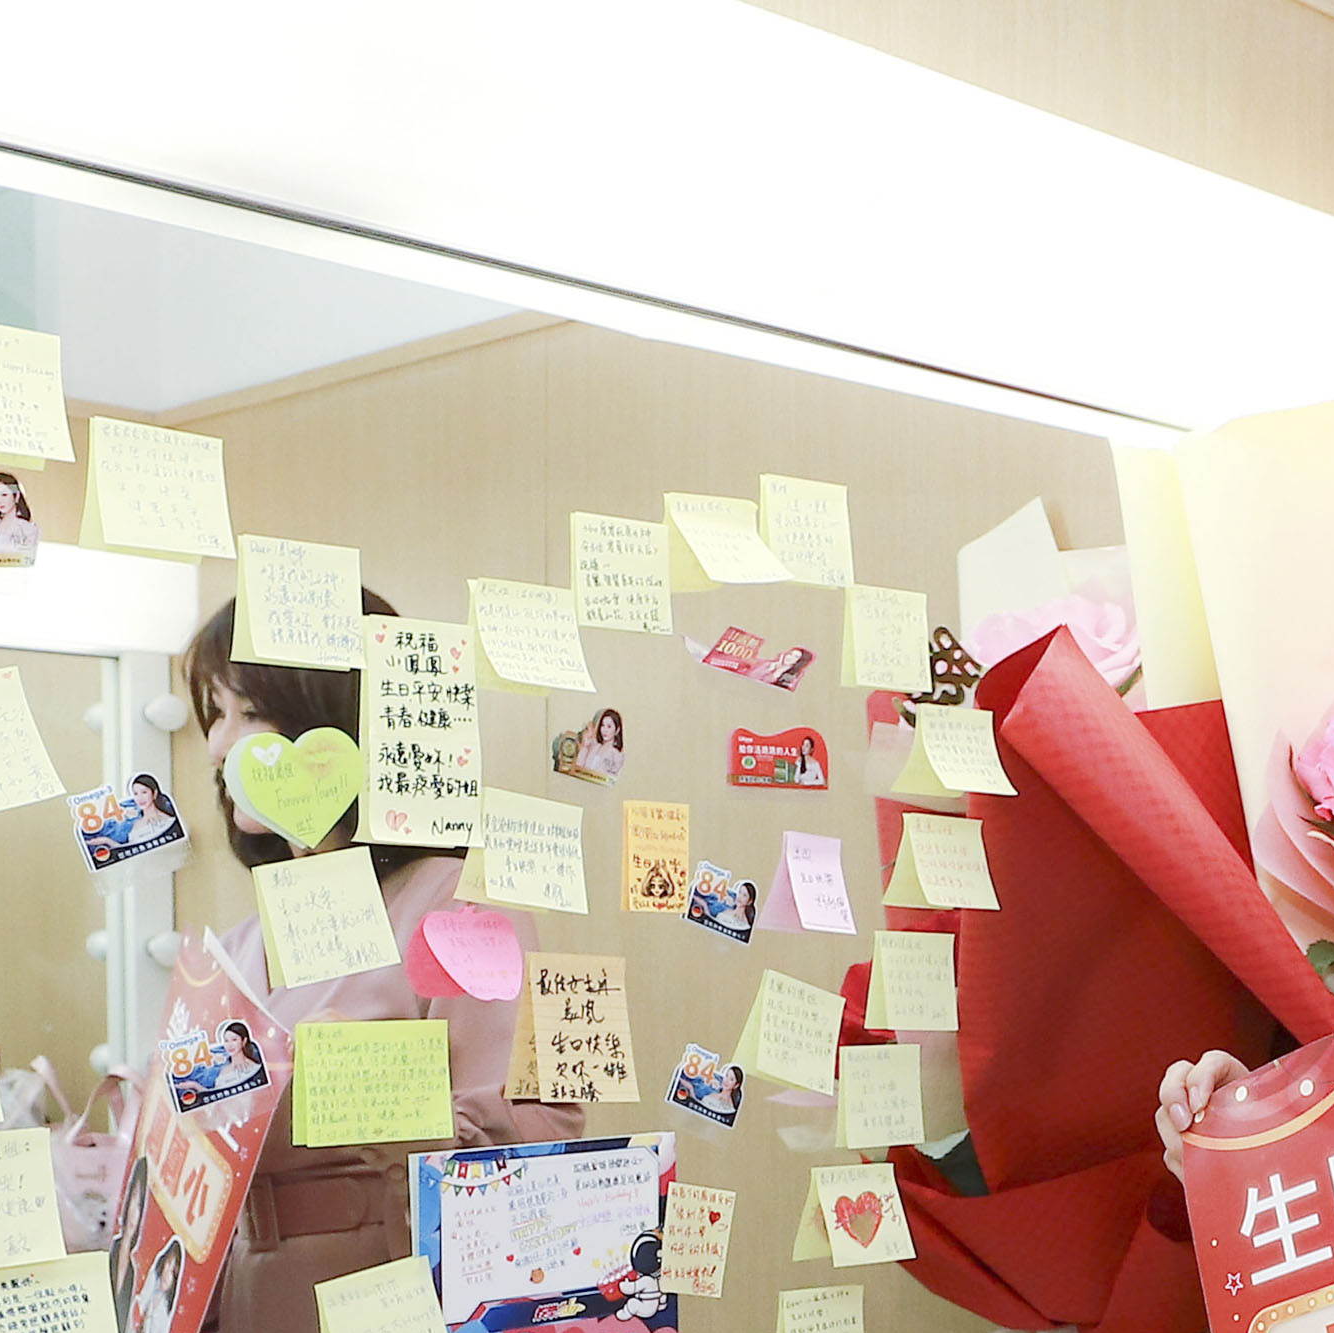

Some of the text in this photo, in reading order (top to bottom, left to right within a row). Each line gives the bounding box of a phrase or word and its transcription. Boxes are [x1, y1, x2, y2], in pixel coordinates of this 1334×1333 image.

[396, 632, 439, 653] 祝福
[385, 654, 456, 677] 小鳳鳳
[78, 795, 124, 831] 84
[431, 817, 473, 843] Nanny
[698, 871, 730, 900] 84
[171, 1041, 213, 1075] 84
[685, 1054, 715, 1084] 84
